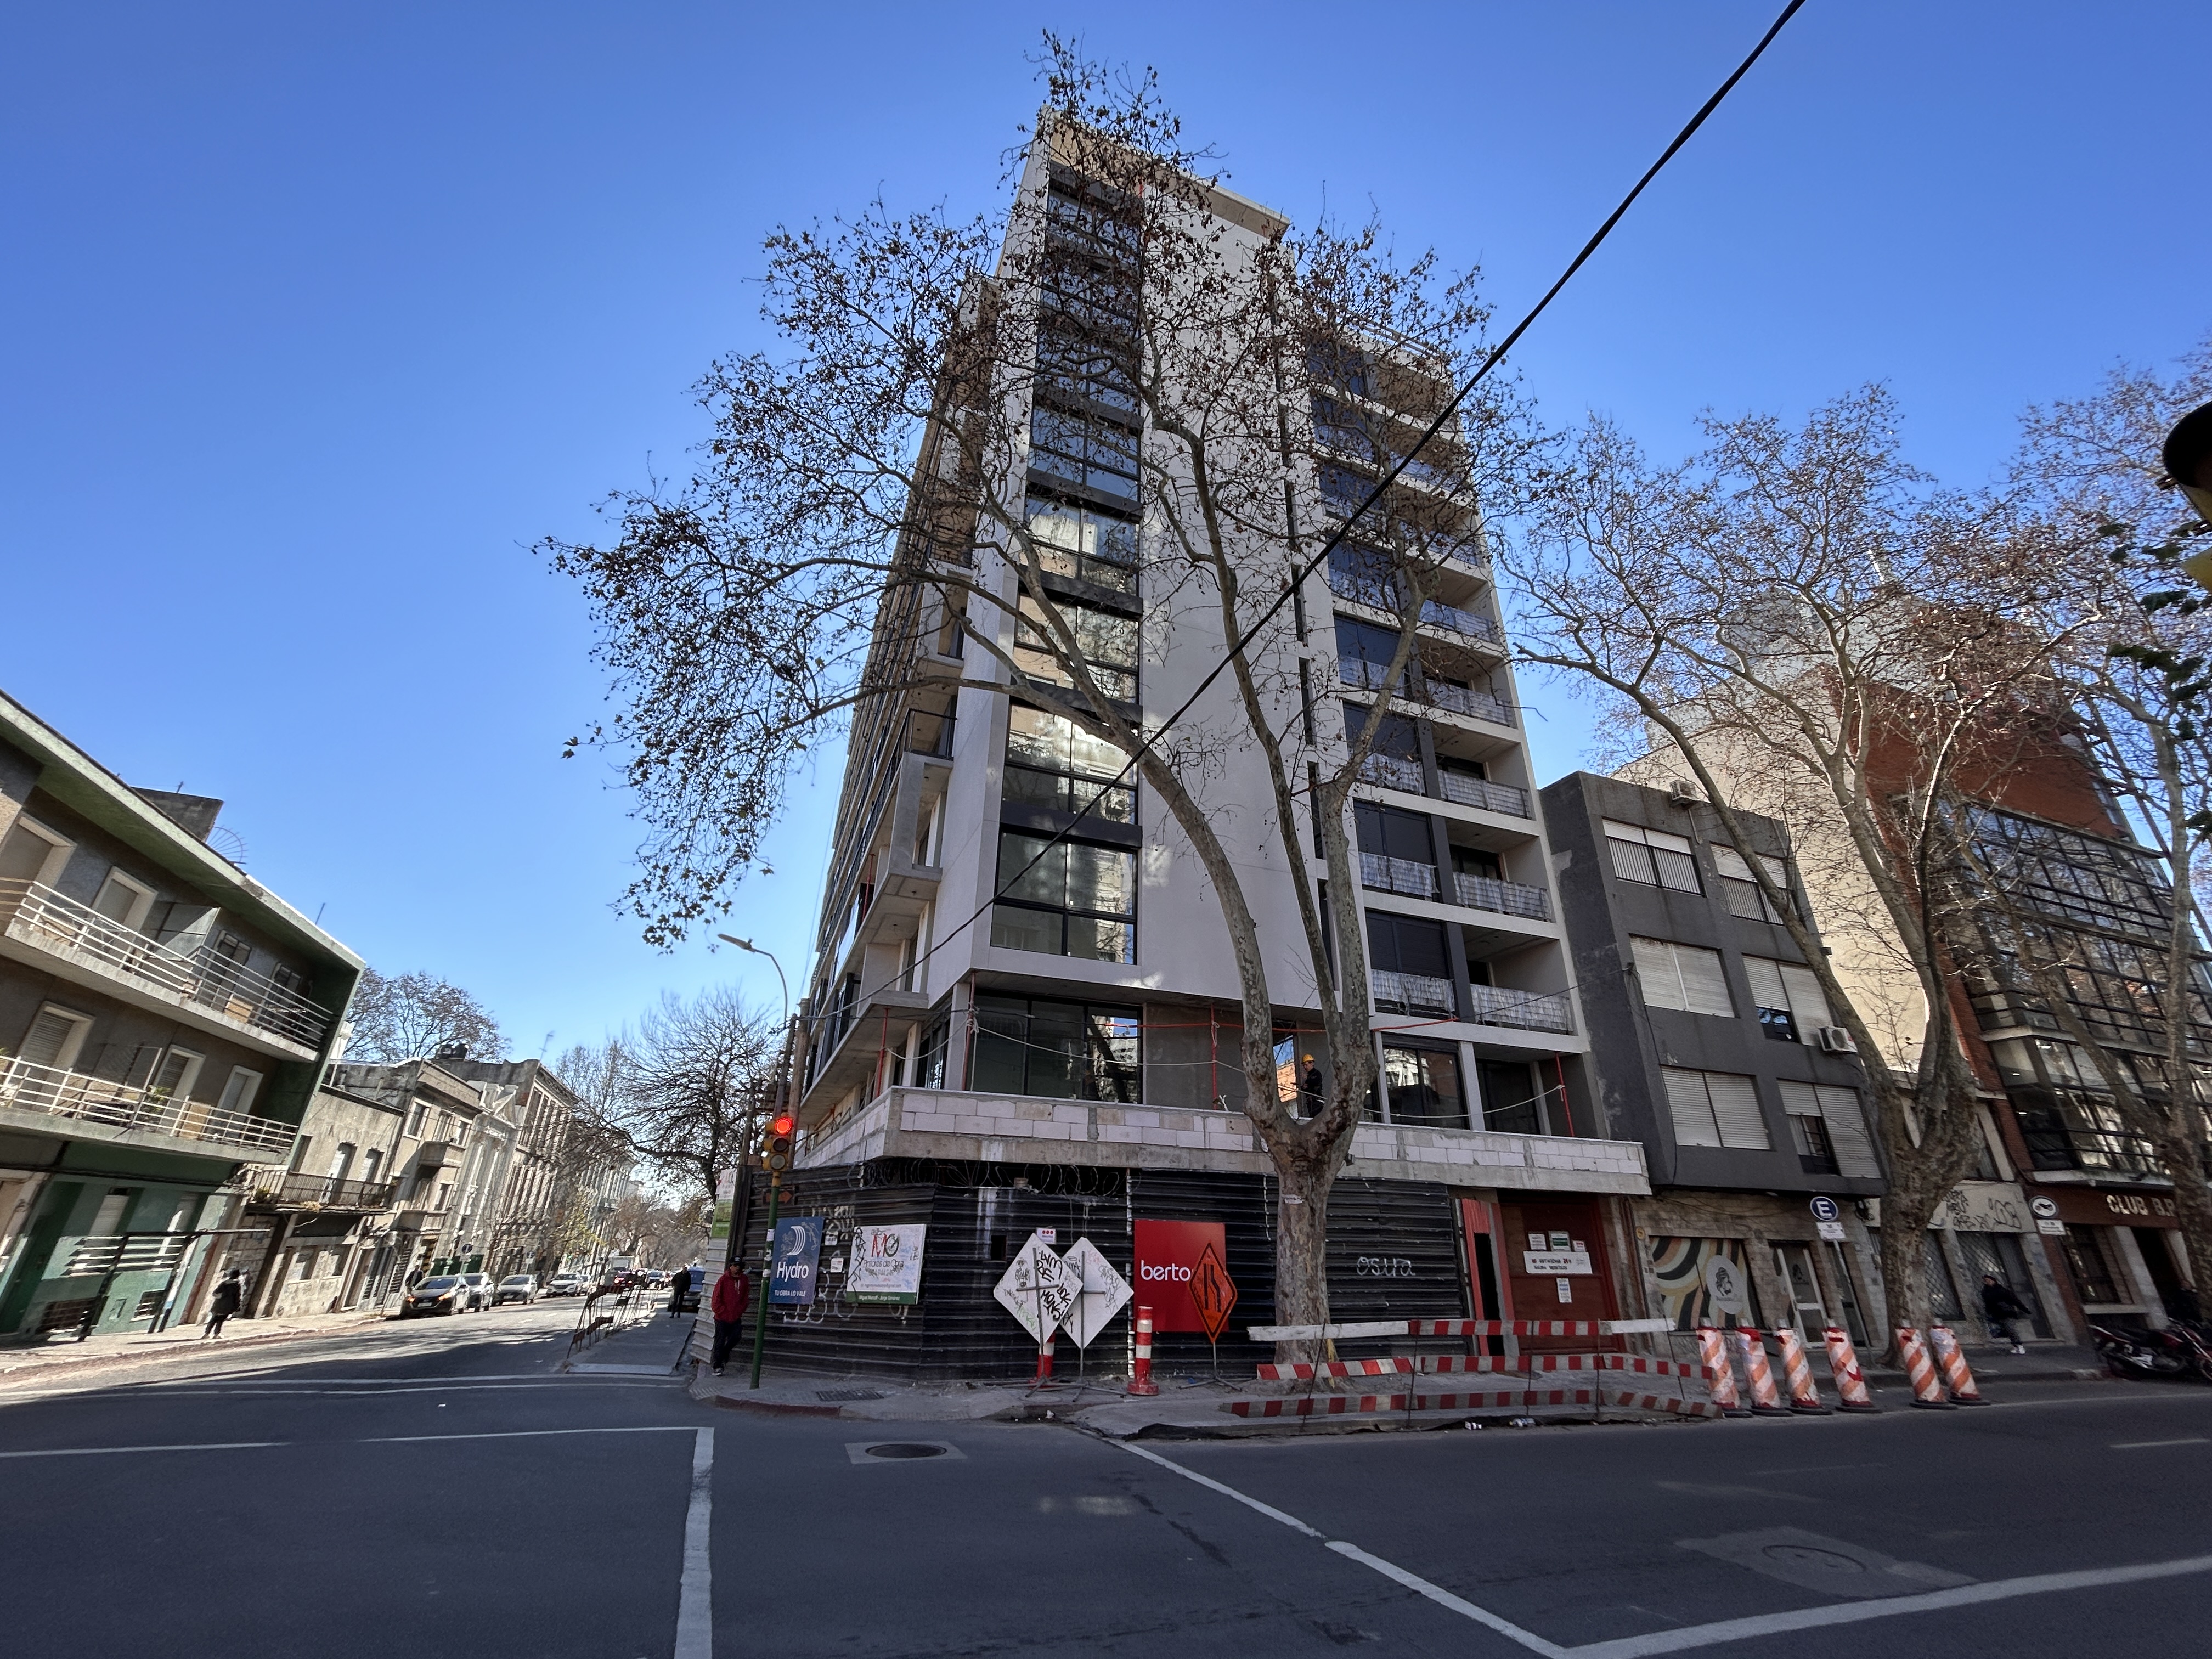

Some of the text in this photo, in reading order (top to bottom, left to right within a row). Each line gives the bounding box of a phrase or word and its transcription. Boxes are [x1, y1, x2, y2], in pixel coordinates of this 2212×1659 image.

[1816, 1201, 1832, 1216] E
[2106, 1195, 2148, 1215] CLUB
[776, 1261, 809, 1282] Hydro
[1141, 1260, 1194, 1282] berto
